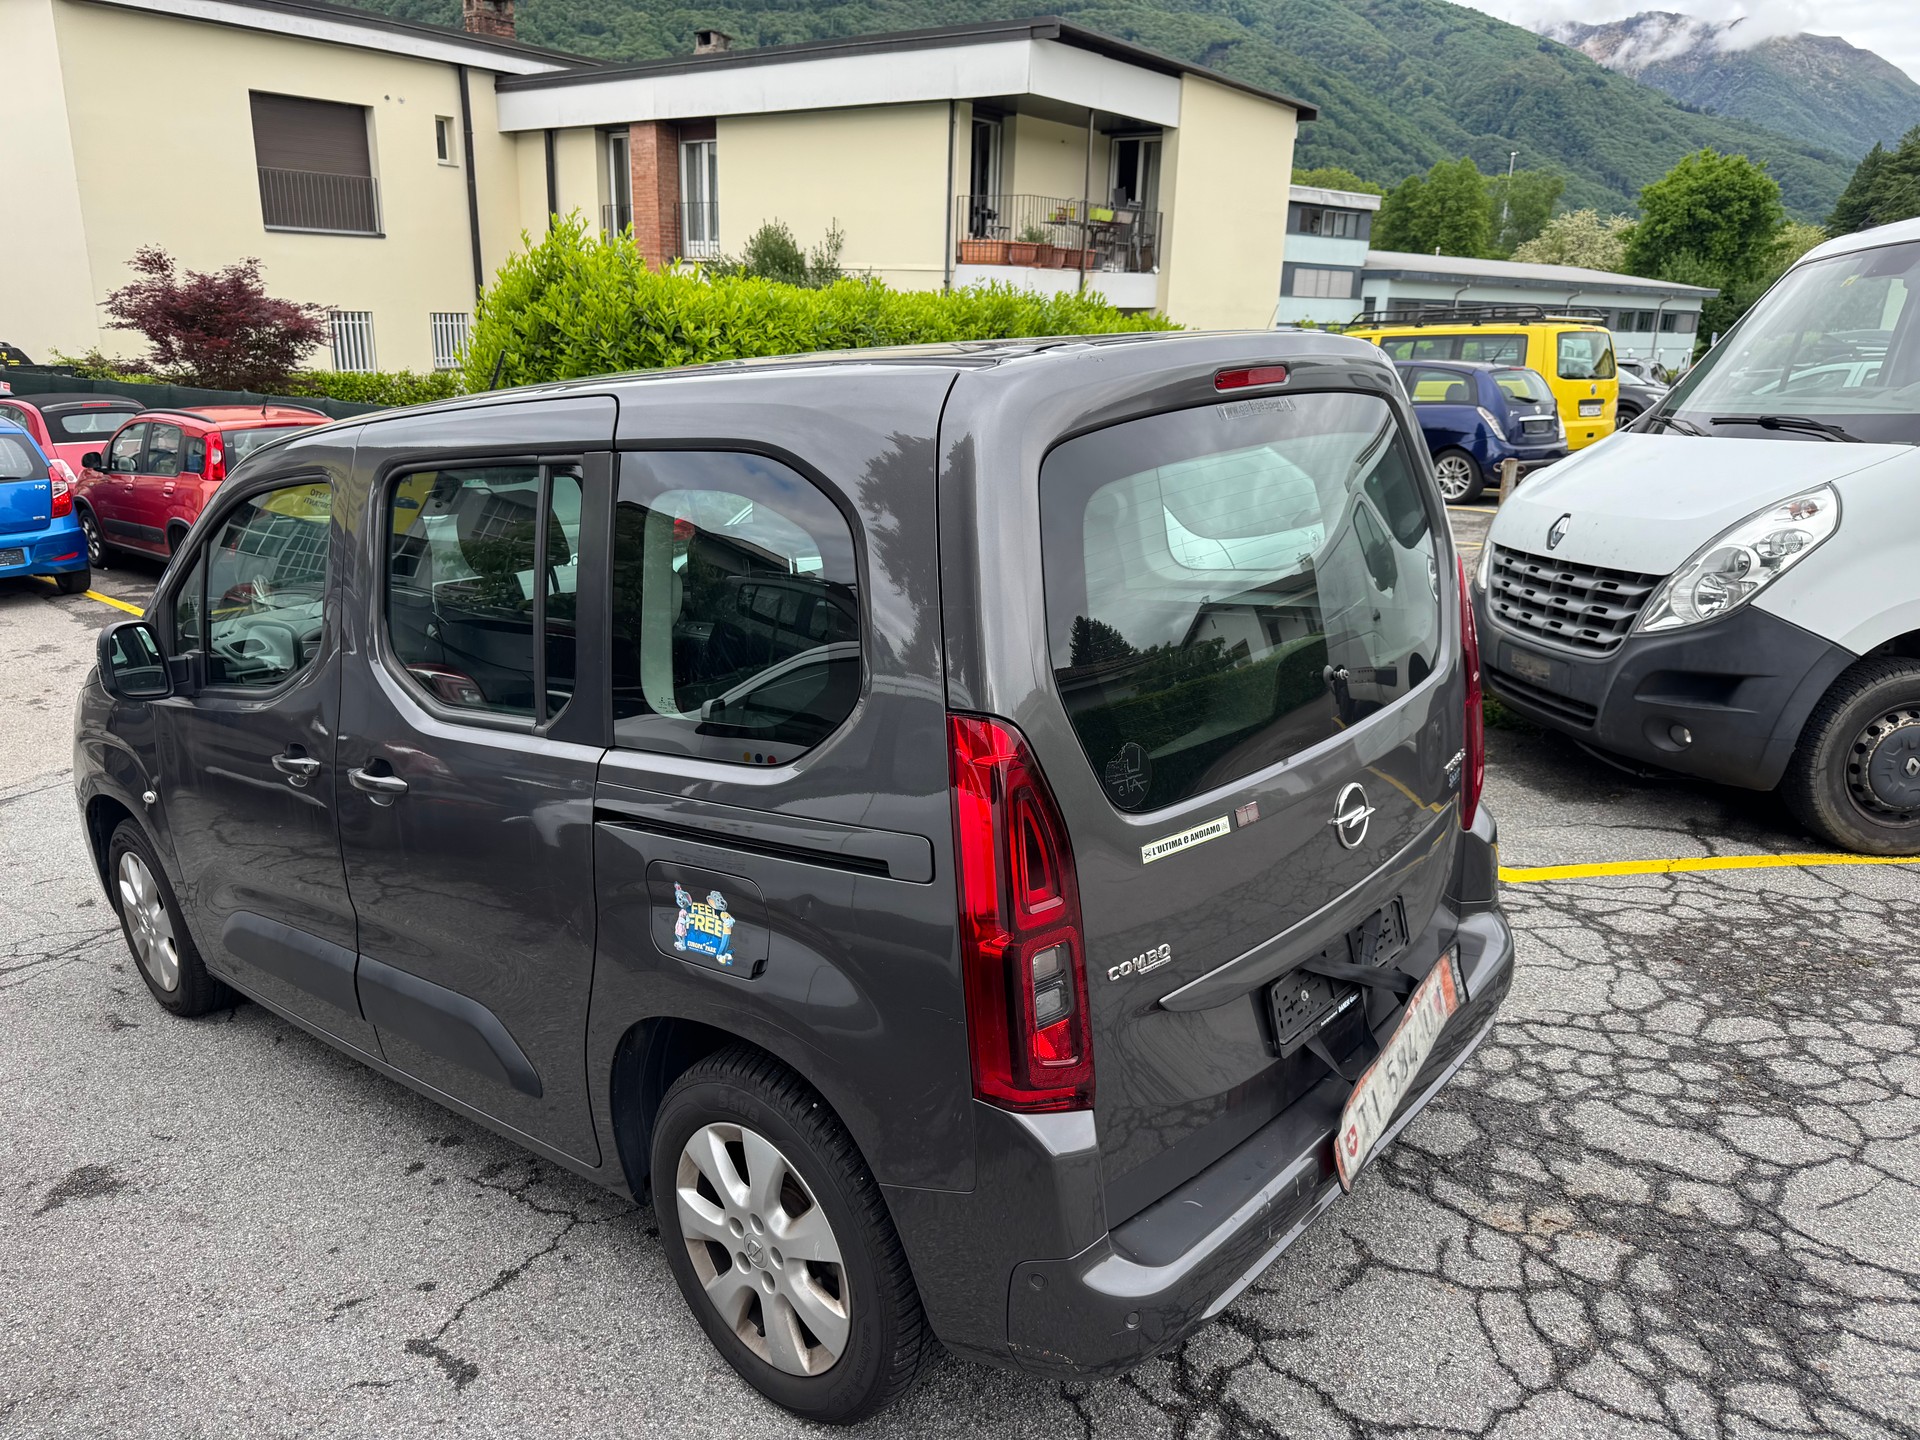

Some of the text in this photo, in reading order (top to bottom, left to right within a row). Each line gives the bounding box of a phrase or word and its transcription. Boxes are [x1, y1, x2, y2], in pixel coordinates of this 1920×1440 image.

[1152, 838, 1183, 856] L'ULTIMA
[1190, 823, 1221, 842] ANDIAMO
[685, 912, 723, 938] FREE
[691, 902, 719, 920] FEEL
[1107, 943, 1171, 981] COMBO
